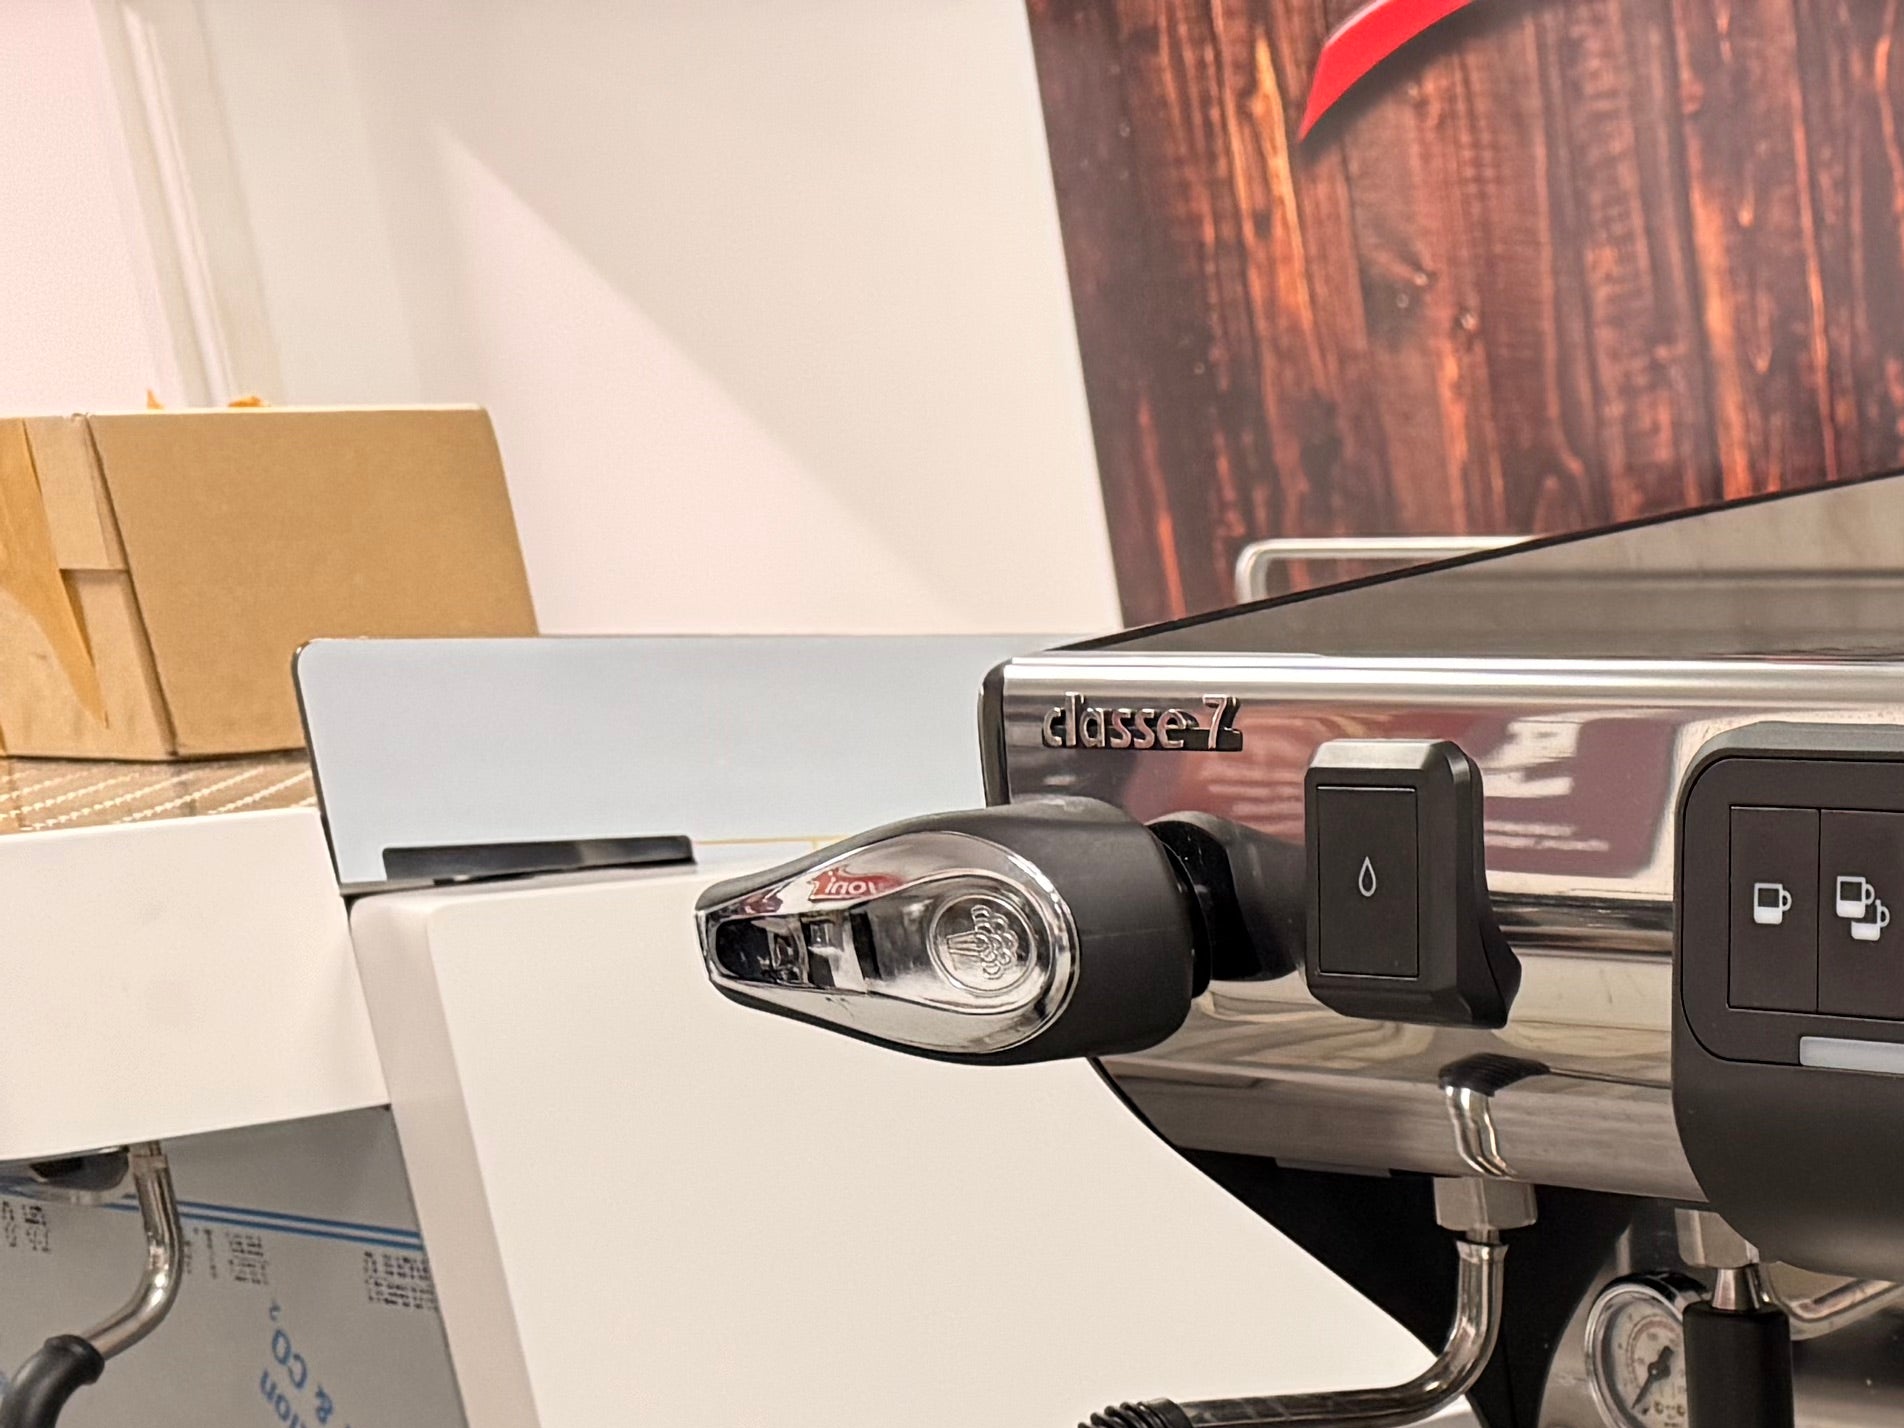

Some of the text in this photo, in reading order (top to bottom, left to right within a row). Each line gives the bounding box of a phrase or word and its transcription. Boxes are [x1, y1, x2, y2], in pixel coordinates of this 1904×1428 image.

[1042, 691, 1232, 751] classe 7
[314, 1387, 335, 1424] &
